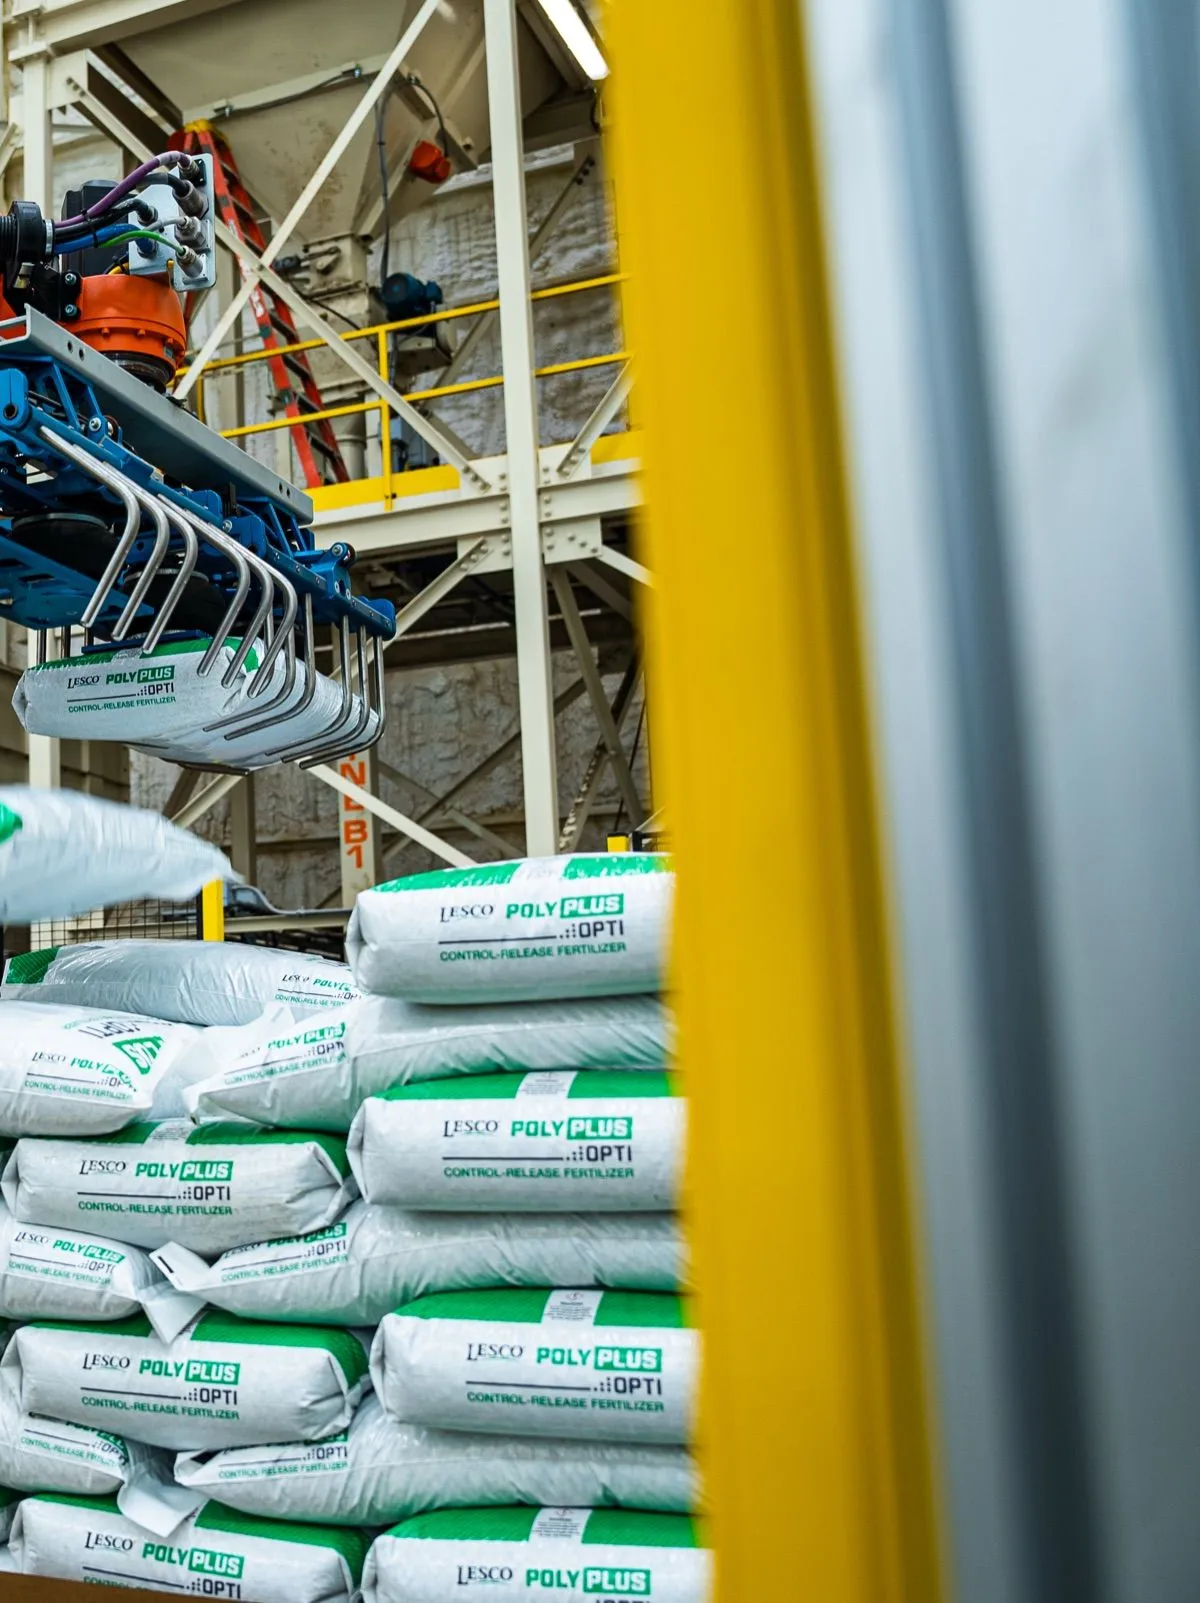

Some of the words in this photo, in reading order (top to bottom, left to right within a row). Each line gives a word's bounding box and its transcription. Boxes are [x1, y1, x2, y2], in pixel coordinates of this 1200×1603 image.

[67, 675, 100, 689] LESCO
[148, 683, 174, 696] OPTI
[137, 697, 176, 708] FERTILIZER
[440, 903, 494, 922] LESCO
[579, 920, 624, 938] OPTI
[557, 942, 626, 956] FERTILIZER
[443, 1119, 498, 1137] LESCO
[586, 1145, 632, 1161] OPTI
[79, 1159, 126, 1175] LESCO
[564, 1167, 634, 1179] FERTILIZER
[193, 1186, 231, 1200] OPTI
[176, 1205, 232, 1215] FERTILIZER
[316, 1240, 347, 1256] OPTI
[466, 1343, 524, 1361] LESCO
[82, 1352, 130, 1370] LESCO
[614, 1377, 662, 1395] OPTI
[199, 1388, 238, 1405] OPTI
[182, 1406, 240, 1420] FERTILIZER
[591, 1399, 665, 1412] FERTILIZER
[316, 1446, 348, 1460] OPTI
[85, 1532, 133, 1550] LESCO
[457, 1565, 514, 1585] LESCO
[202, 1579, 241, 1599] OPTI
